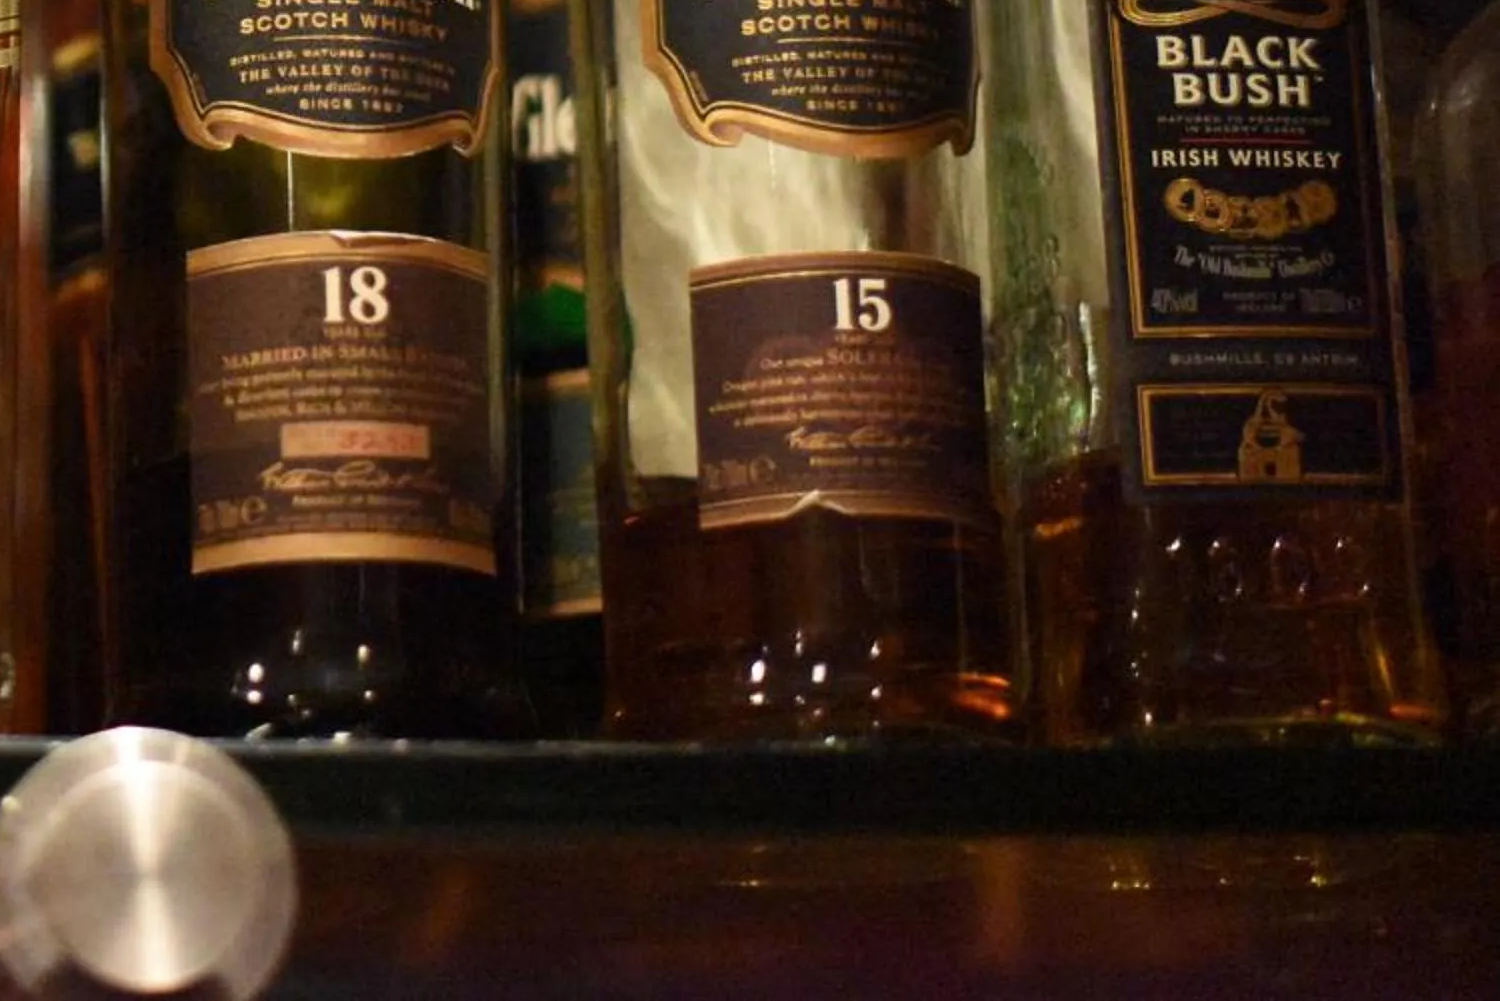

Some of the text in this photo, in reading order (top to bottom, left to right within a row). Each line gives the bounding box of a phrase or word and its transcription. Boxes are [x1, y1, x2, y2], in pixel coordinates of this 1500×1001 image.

[239, 12, 449, 42] SCOTCH WHISKY
[741, 15, 850, 36] SCOTCH
[1156, 34, 1322, 70] BLACK
[239, 68, 271, 84] THE
[277, 64, 344, 79] VALLEY
[351, 66, 372, 78] OF
[742, 68, 775, 84] THE
[783, 65, 846, 79] VALLEY
[1173, 72, 1312, 107] BUSH
[299, 98, 354, 110] SINCE
[805, 100, 858, 111] SINCE
[1151, 150, 1342, 169] IRISH WHISKEY
[322, 266, 389, 324] 18
[833, 278, 892, 331] 15
[222, 346, 307, 369] MARRIED
[311, 345, 334, 360] IN
[338, 344, 396, 361] SMAL
